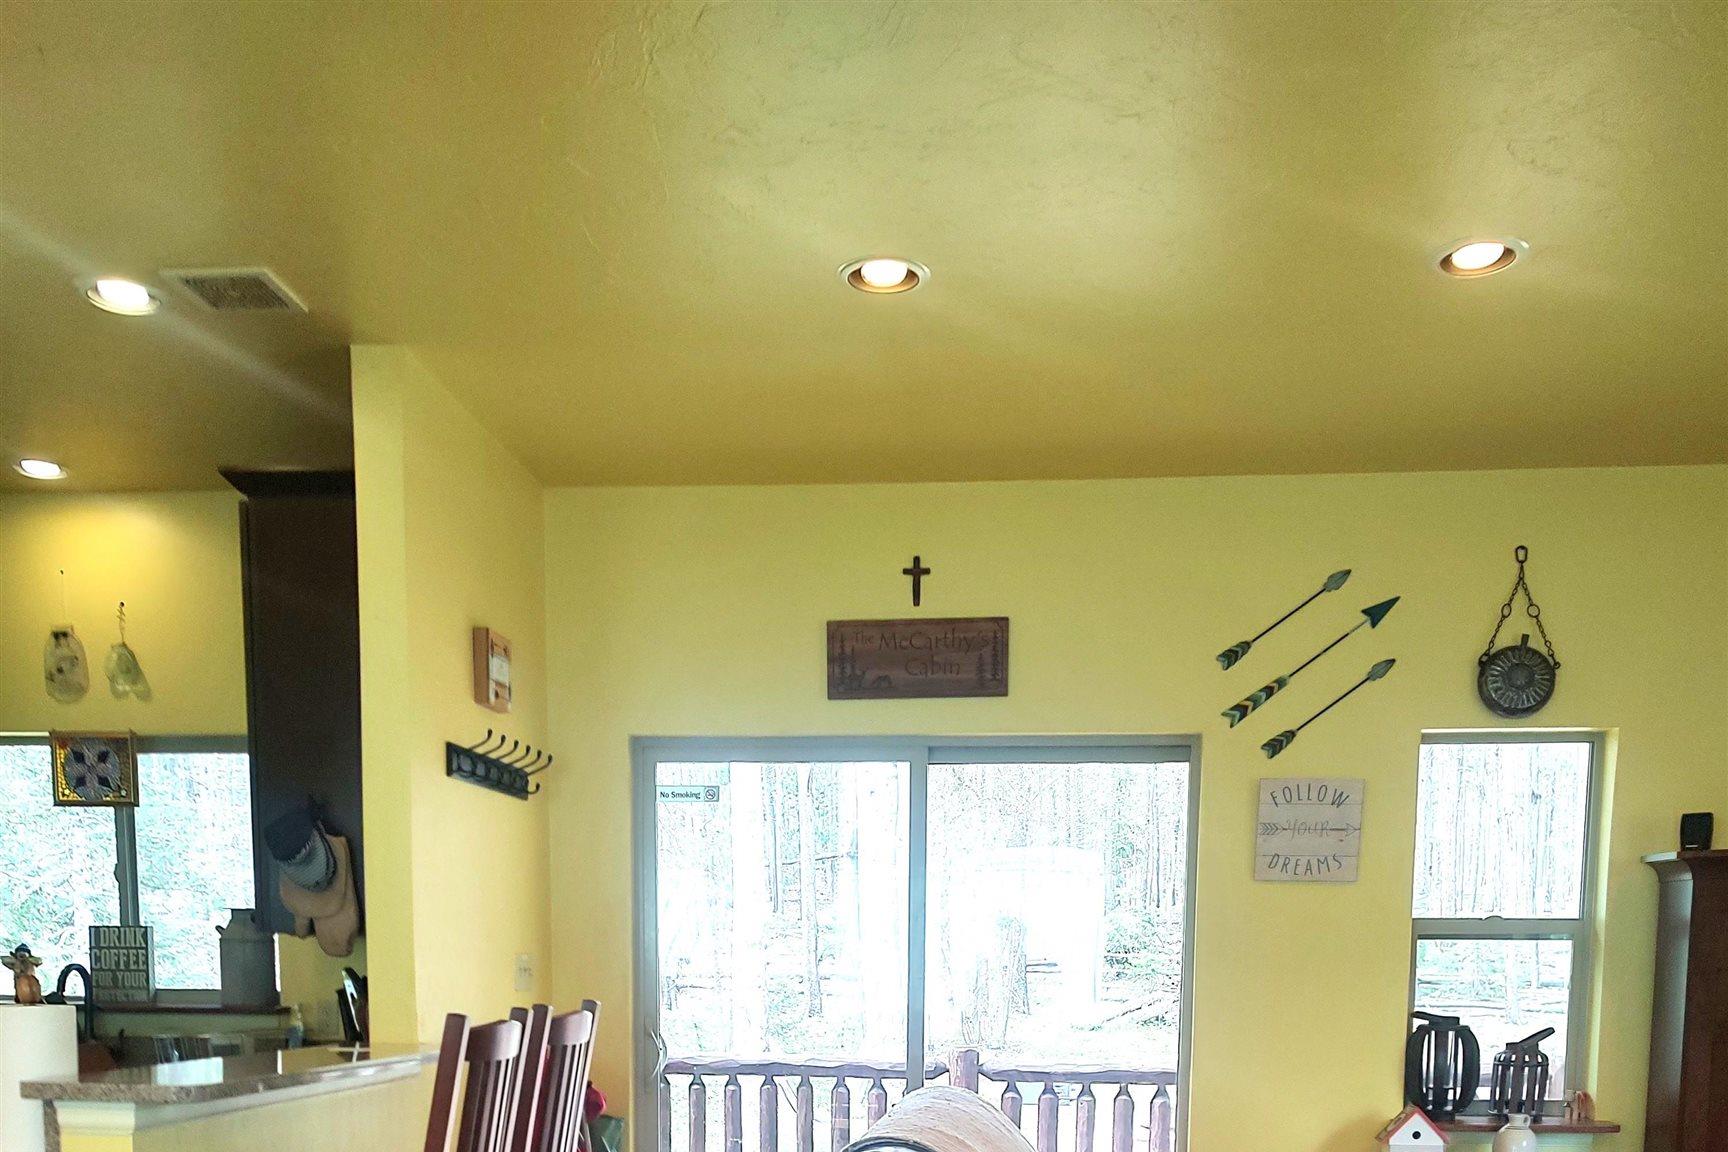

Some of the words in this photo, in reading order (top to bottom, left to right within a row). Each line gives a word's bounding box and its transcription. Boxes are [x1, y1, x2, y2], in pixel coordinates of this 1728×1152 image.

[905, 654, 960, 678] Cabin
[671, 791, 701, 799] Smoking
[1270, 784, 1350, 808] FOLLOW
[1268, 853, 1342, 875] DREAMS
[91, 927, 95, 947] I
[100, 927, 146, 947] DRINK
[91, 949, 146, 969] COFFEE
[92, 971, 113, 986] FOR
[117, 971, 147, 987] YOUR
